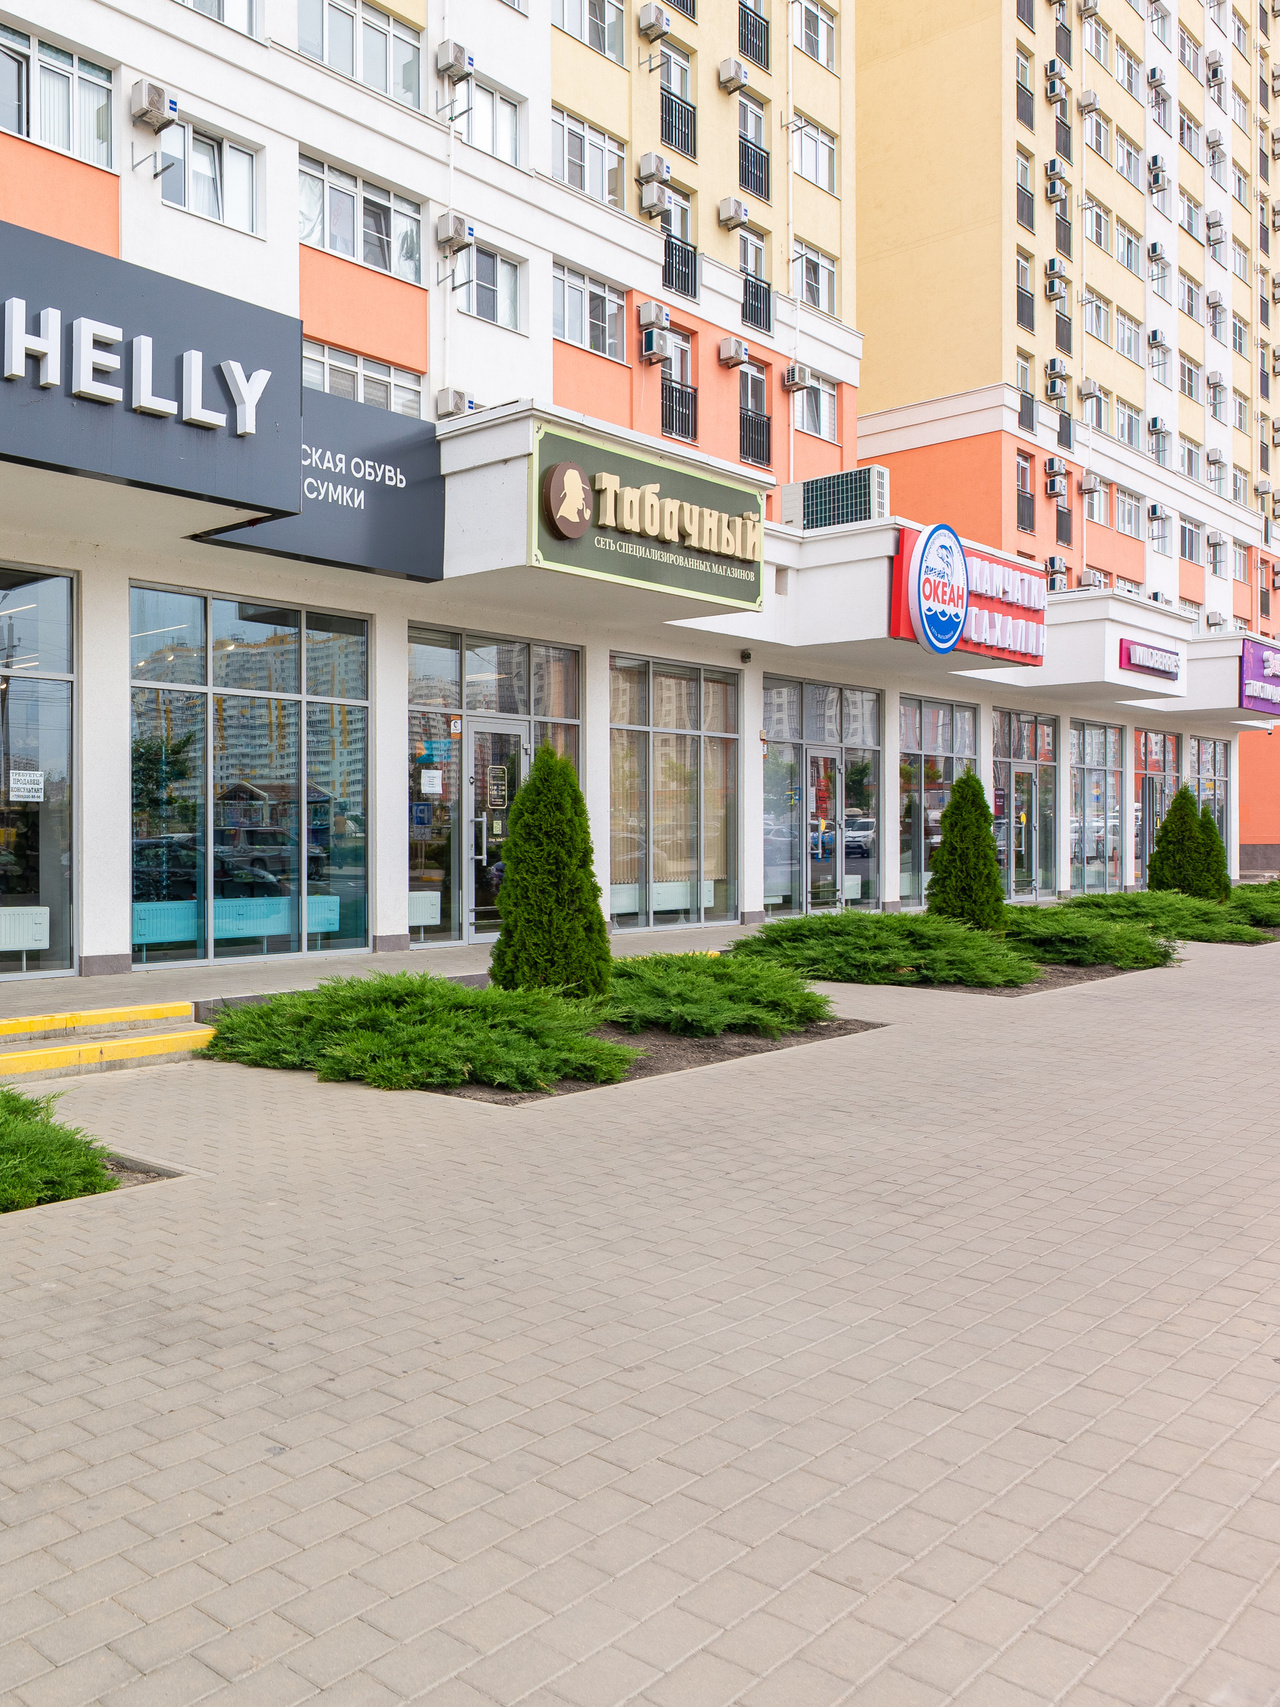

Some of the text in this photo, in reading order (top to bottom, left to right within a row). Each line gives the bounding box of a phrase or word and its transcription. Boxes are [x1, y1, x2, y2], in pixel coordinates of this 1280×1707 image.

[303, 477, 365, 510] СУМКИ
[350, 457, 407, 488] ОБУВЬ
[595, 471, 761, 563] Табачный
[594, 536, 755, 582] СЕТЬ СПЕЦИАЛИЗИРОВАННЫХ МАГАЗИНОВ
[922, 577, 965, 610] ОКЕАН
[966, 557, 1048, 611] КАМЧАТКА
[963, 607, 1048, 657] САХАЛИН
